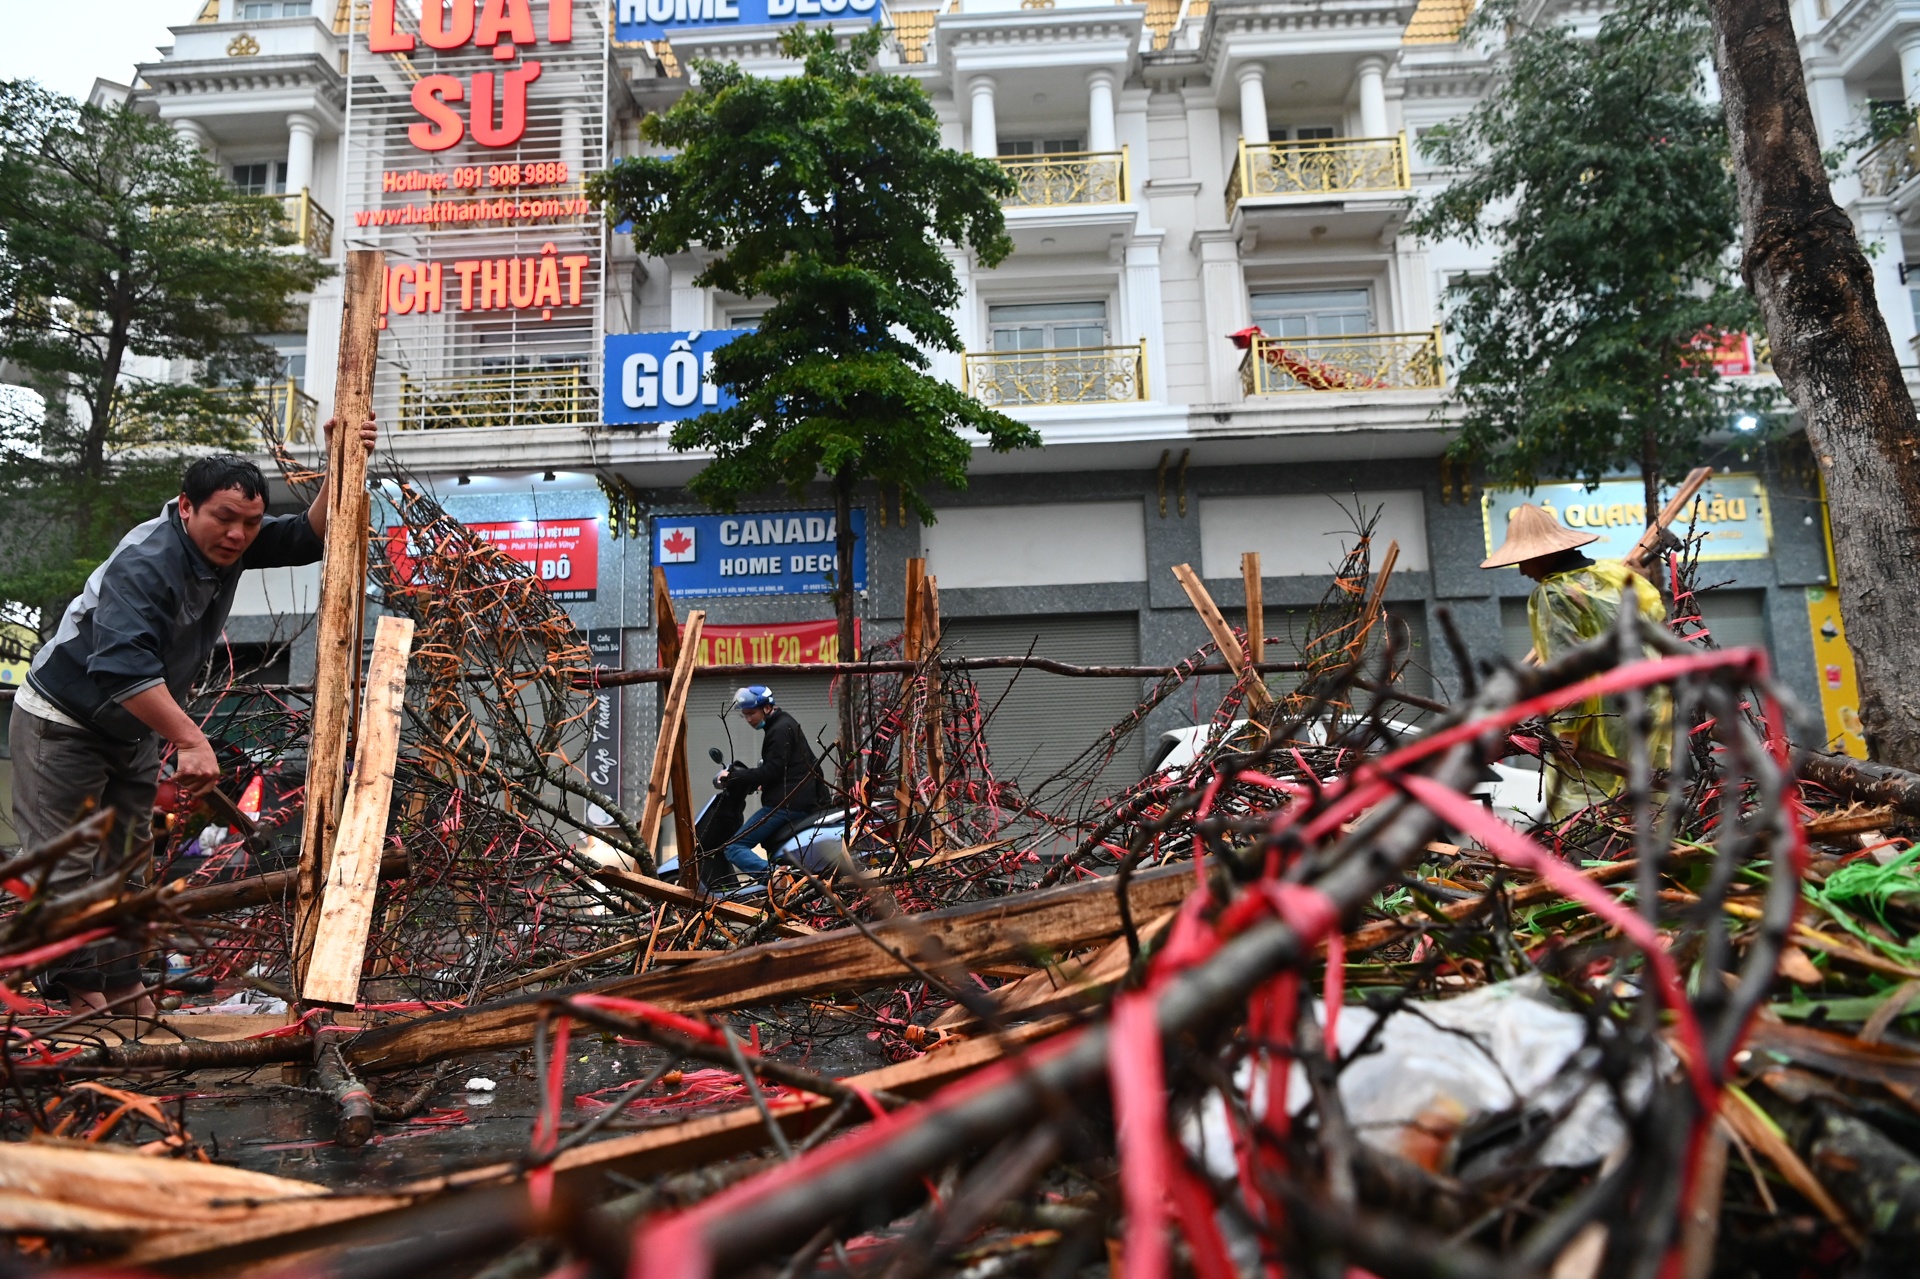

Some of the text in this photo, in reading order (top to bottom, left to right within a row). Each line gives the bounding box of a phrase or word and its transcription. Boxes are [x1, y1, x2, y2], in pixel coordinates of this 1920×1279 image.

[408, 61, 541, 151] SƯ
[383, 162, 568, 192] Hotline: 091 908 9888
[379, 242, 590, 330] ỊCH THUẬT
[563, 527, 580, 538] NAM
[719, 517, 839, 546] CANADA
[541, 554, 571, 580] ĐÔ
[719, 557, 782, 576] HOME
[715, 632, 745, 664] GIÁ
[749, 631, 774, 664] TỪ
[778, 636, 800, 664] 20
[590, 748, 618, 786] Cafe
